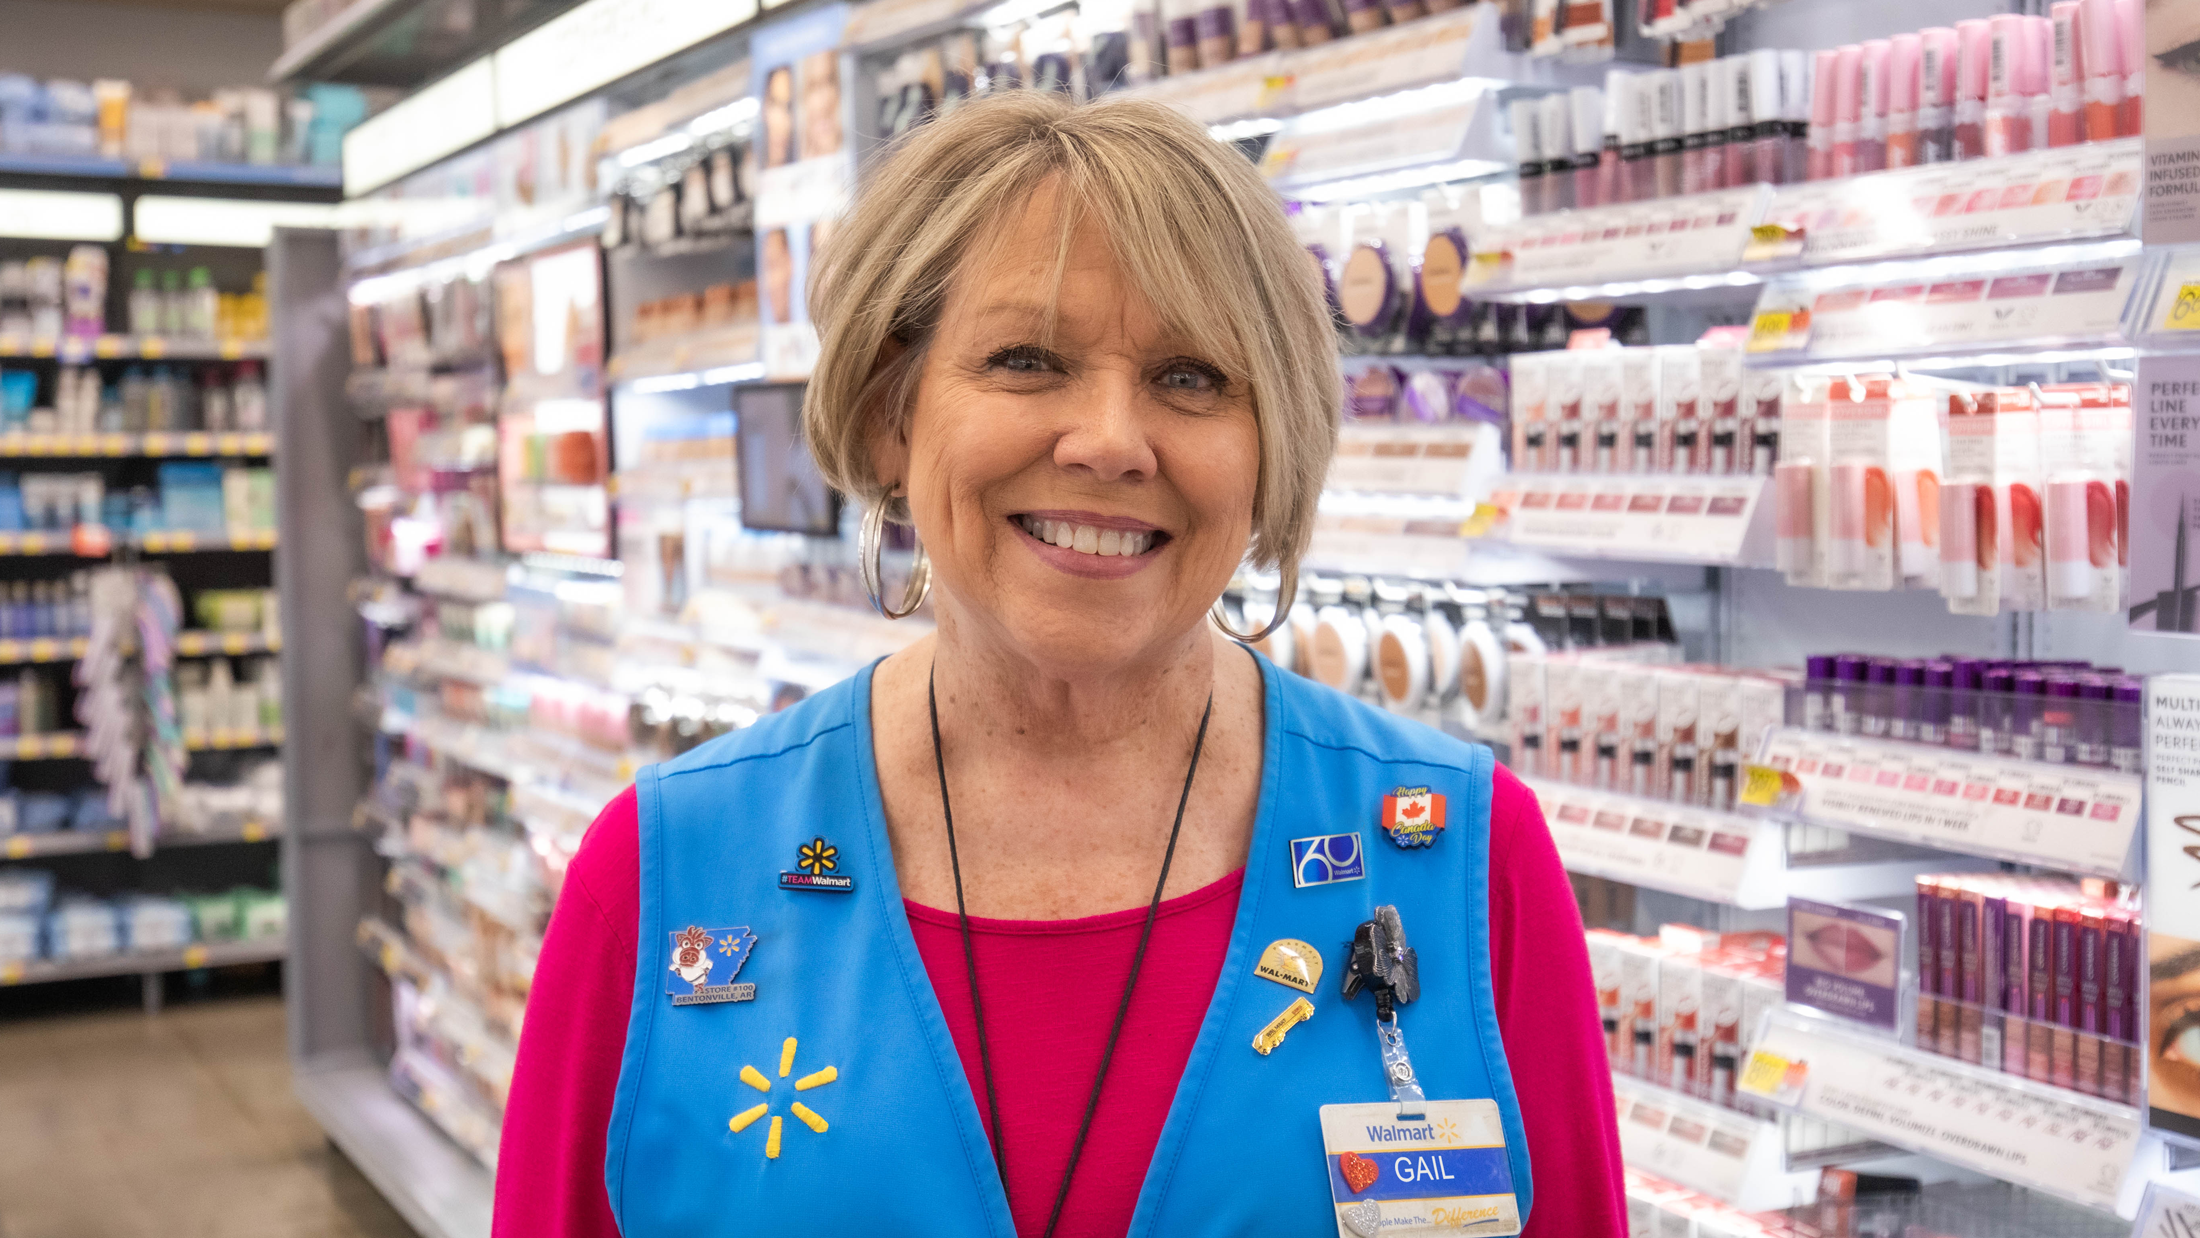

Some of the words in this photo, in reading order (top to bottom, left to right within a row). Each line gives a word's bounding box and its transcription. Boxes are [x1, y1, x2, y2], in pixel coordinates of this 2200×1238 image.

[2151, 150, 2200, 166] VITAMIN
[2150, 165, 2200, 181] INFUSED
[2151, 399, 2187, 413] LINE
[2150, 416, 2200, 431] EVERY
[2150, 433, 2187, 448] TIME
[1392, 786, 1428, 799] Happy
[1390, 820, 1436, 837] Canada
[1944, 818, 1970, 832] WEEK
[1410, 833, 1433, 845] Day
[1334, 868, 1354, 876] Walmart
[781, 874, 851, 887] #TEAMWalmart
[704, 986, 731, 994] STORE
[733, 984, 754, 992] #100
[676, 993, 738, 1003] BENTONVILLE,
[1367, 1123, 1435, 1142] Walmart
[1941, 1130, 2004, 1157] OVERDRAWN
[1395, 1155, 1455, 1183] GAIL
[1394, 1217, 1413, 1226] Make
[1431, 1206, 1499, 1228] Difference
